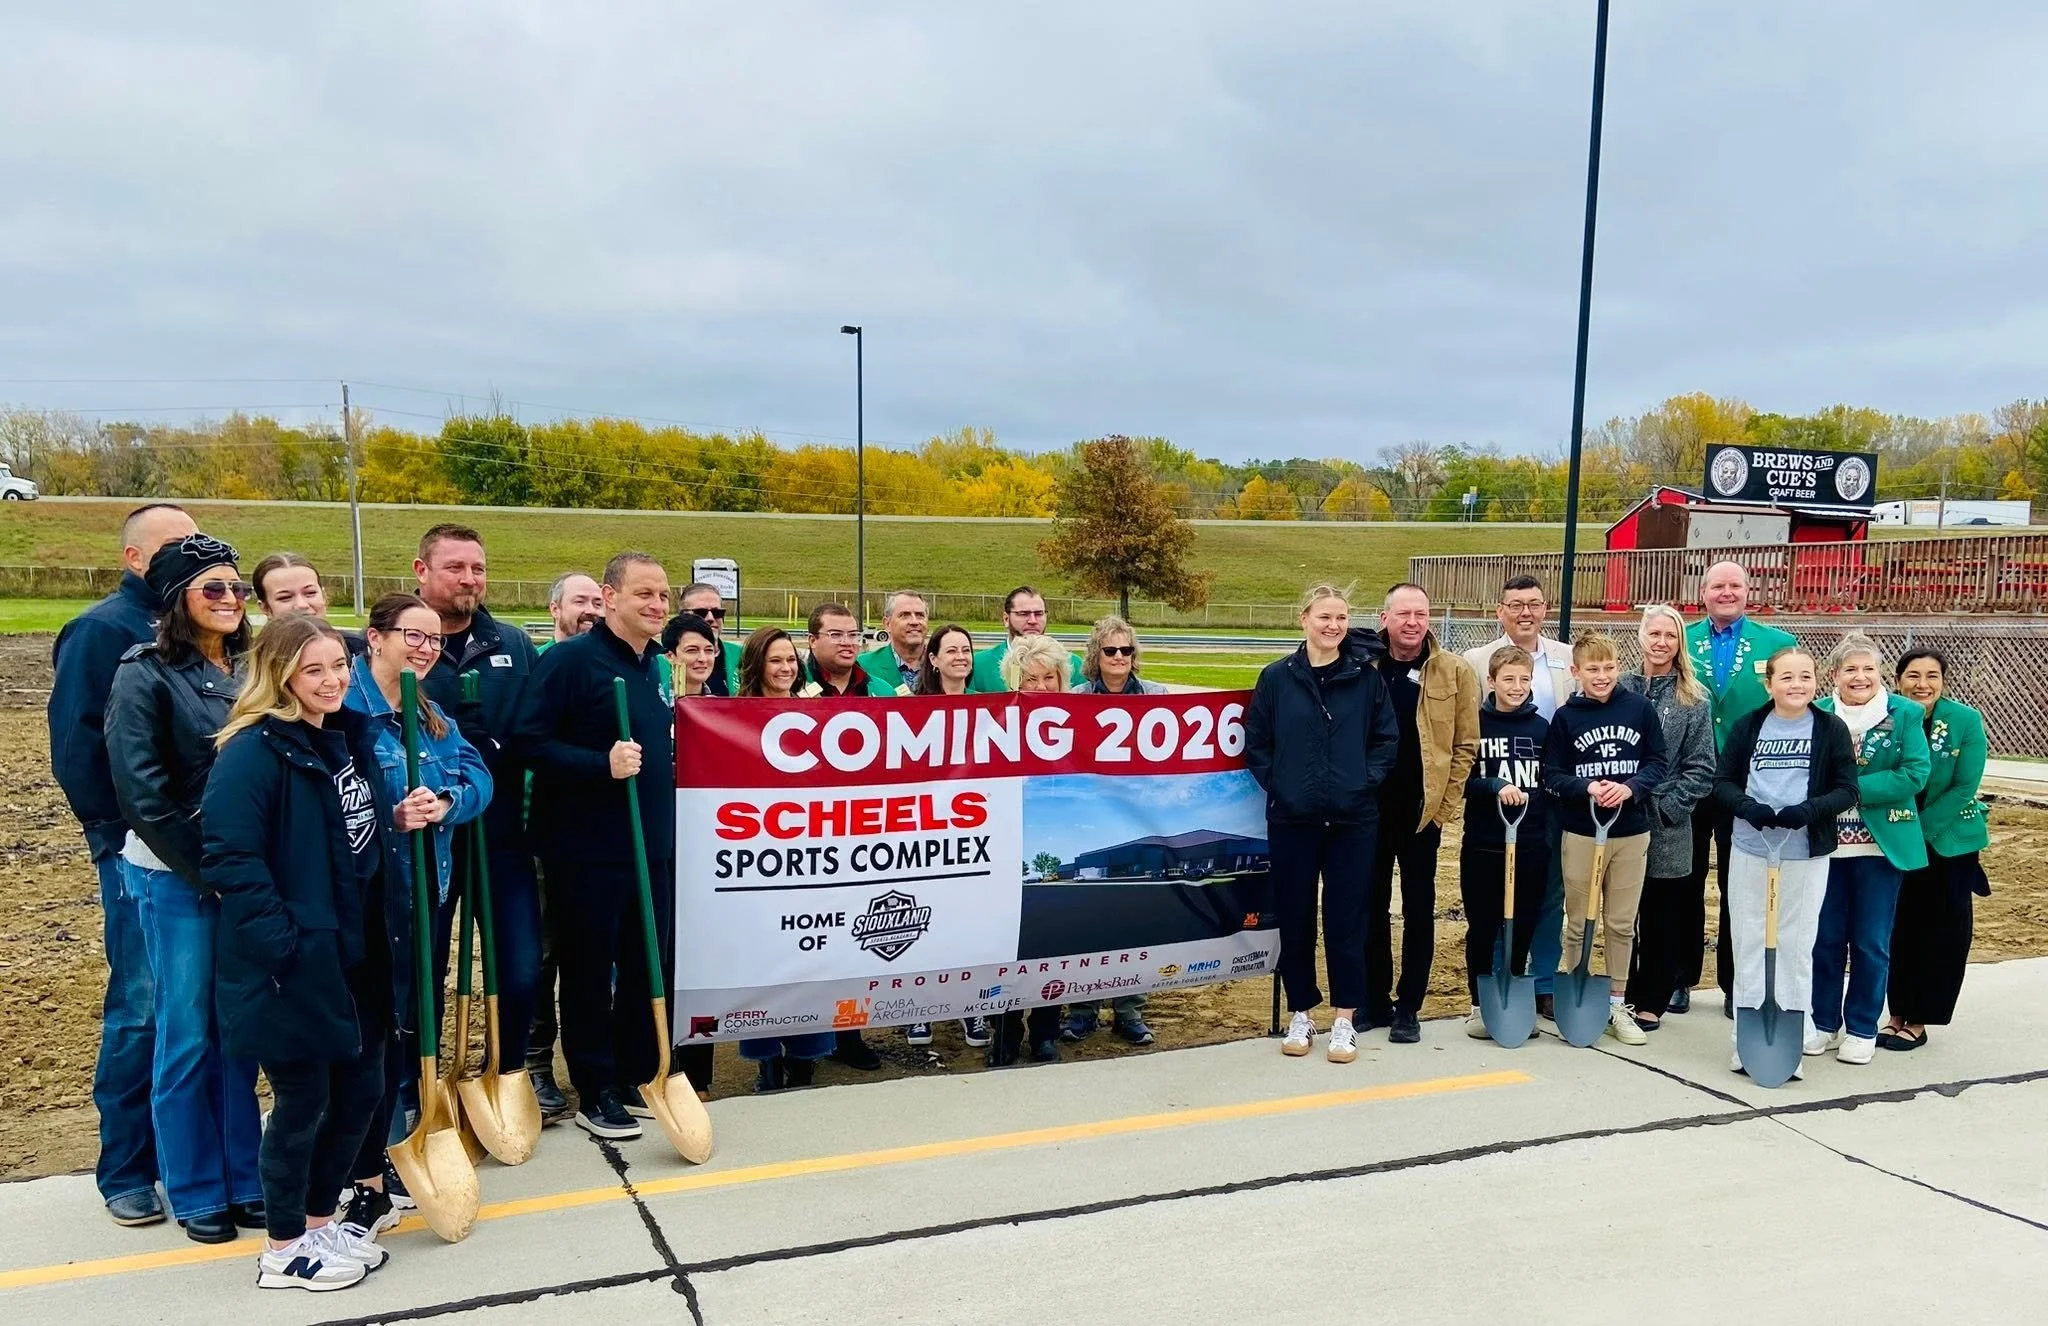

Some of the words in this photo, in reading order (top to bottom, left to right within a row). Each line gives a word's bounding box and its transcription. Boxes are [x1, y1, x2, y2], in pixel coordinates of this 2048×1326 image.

[1752, 452, 1813, 470] BREWS
[1813, 457, 1834, 469] AND
[1766, 470, 1817, 487] CUE'S
[1769, 487, 1795, 497] CRAFT
[1795, 489, 1816, 499] BEER
[760, 705, 1075, 773] COMING
[1094, 703, 1246, 762] 2026
[1574, 725, 1641, 752] SIOUXLAND
[1479, 737, 1509, 758] THE
[1575, 760, 1640, 778] EVERYBODY
[715, 792, 988, 840] SCHEELS
[714, 846, 839, 879] SPORTS
[850, 836, 991, 874] COMPLEX
[781, 912, 846, 930] HOME
[853, 907, 931, 936] SIOUXLAND
[799, 935, 827, 952] OF
[1188, 959, 1221, 973] MRHD
[1232, 950, 1270, 964] CHESTERMAN
[869, 971, 971, 991] PROUD
[998, 951, 1149, 977] PARTNERS
[1231, 960, 1265, 974] FOUNDATION
[1067, 974, 1142, 995] PeoplesBank
[871, 1003, 951, 1021] ARCHITECTS
[874, 998, 916, 1012] CMBA
[724, 1014, 819, 1029] CONSTRUCTION
[725, 1010, 768, 1020] PERRY
